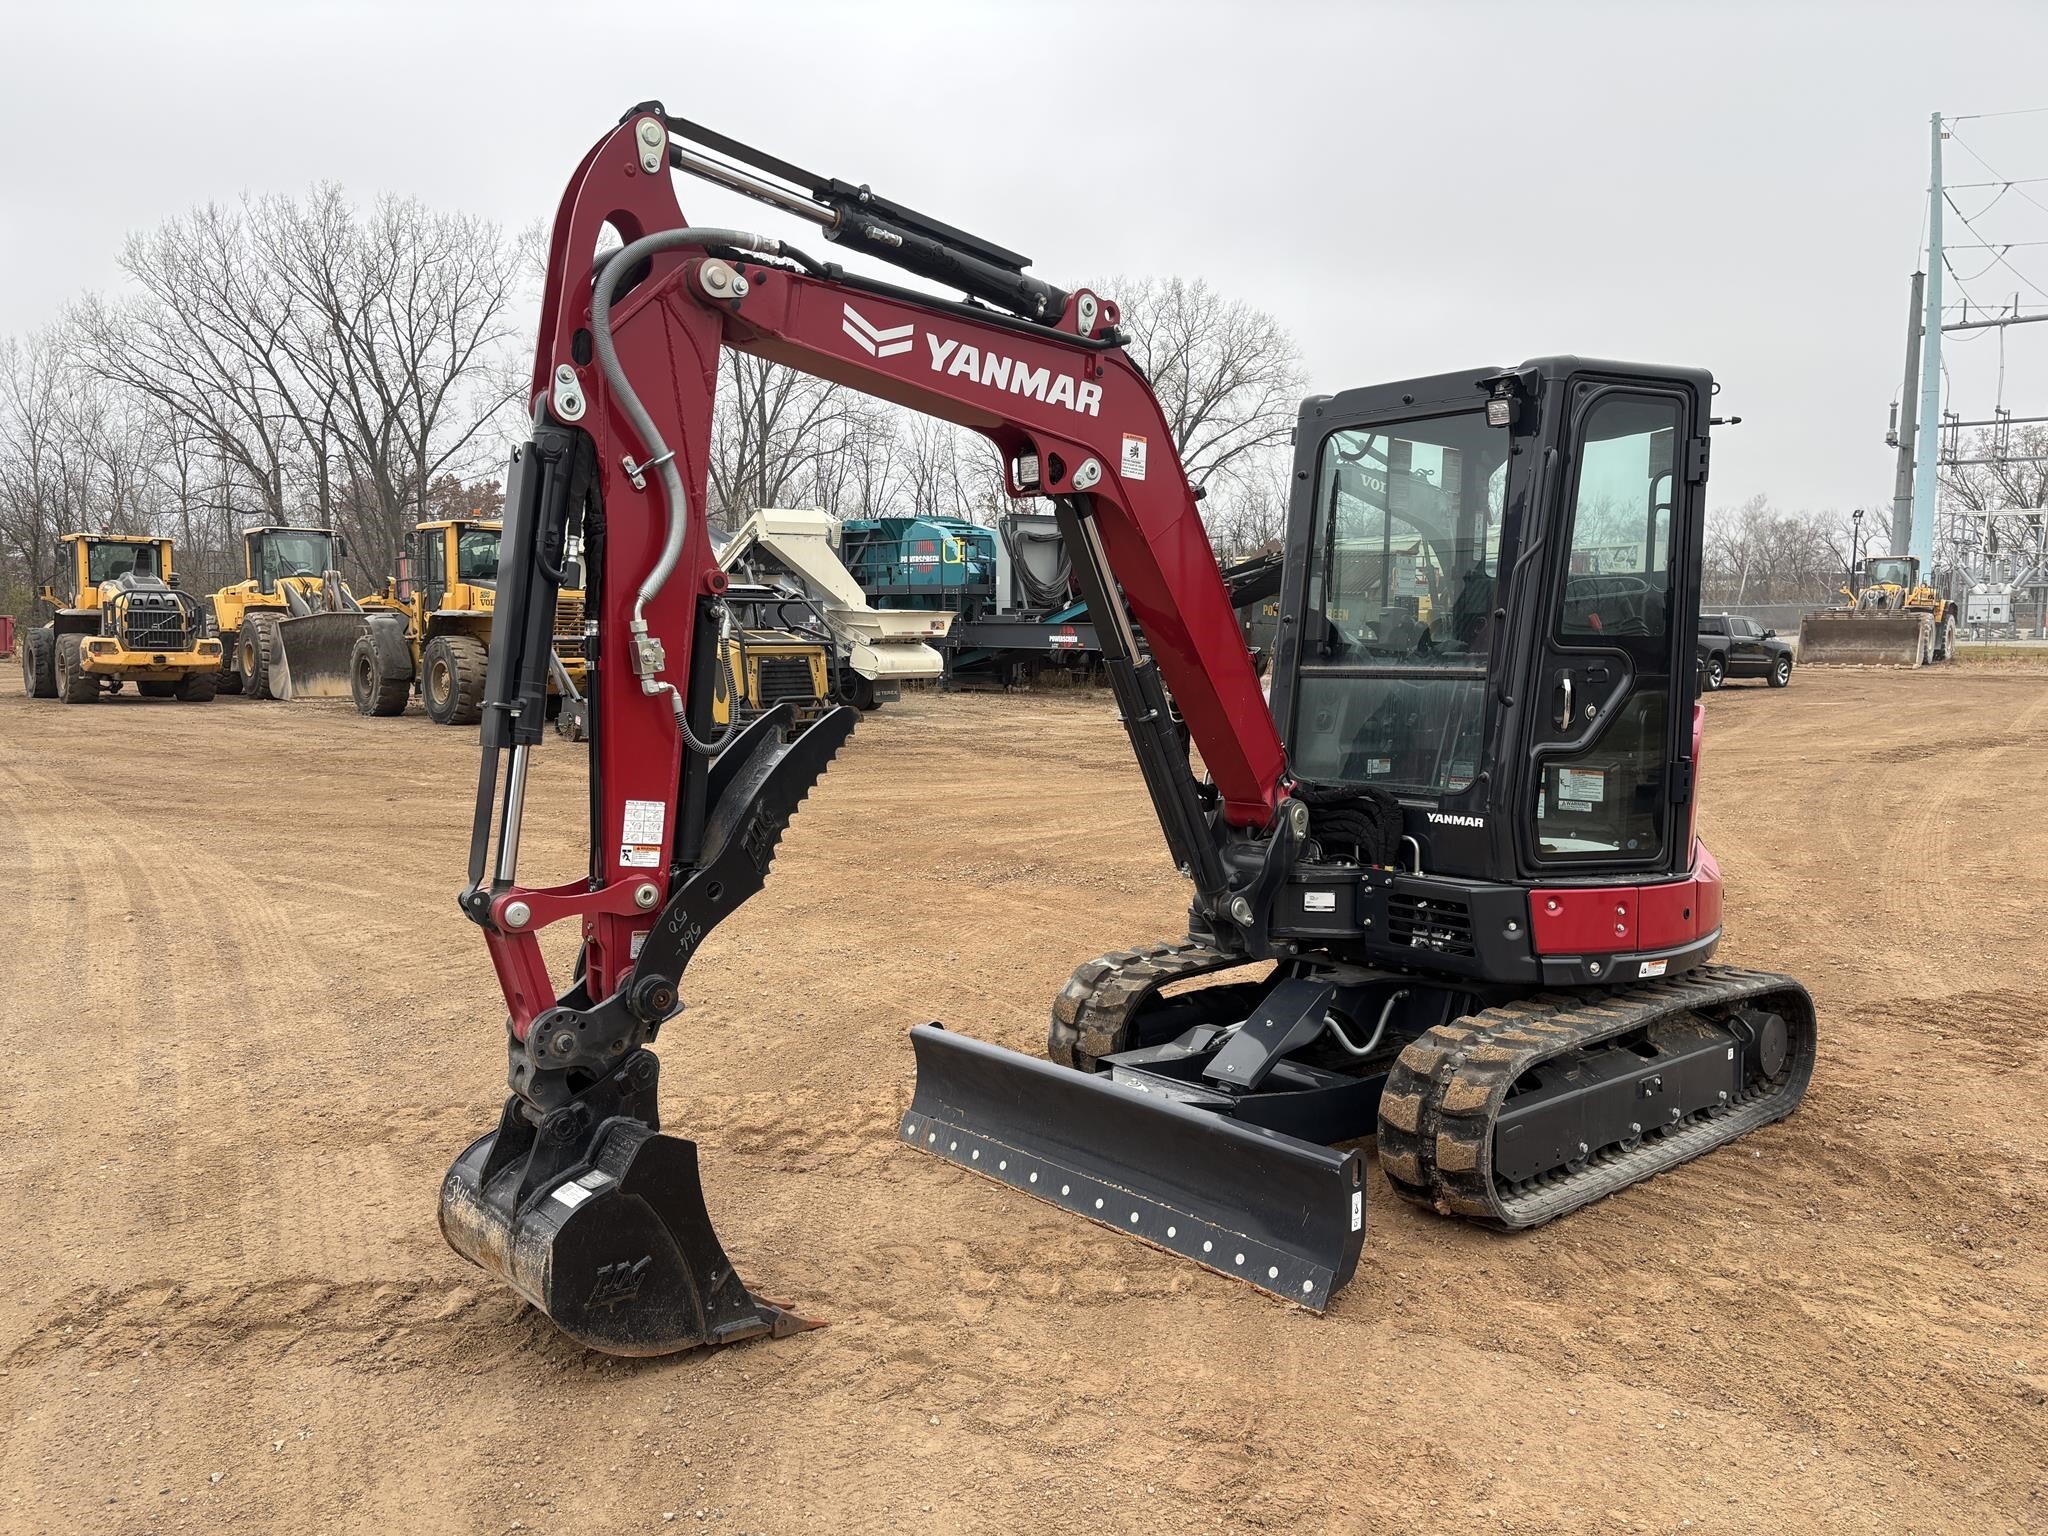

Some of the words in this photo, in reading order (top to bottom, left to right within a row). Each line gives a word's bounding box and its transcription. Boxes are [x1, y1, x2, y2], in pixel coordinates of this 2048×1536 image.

[926, 332, 1103, 417] YANMAR
[1360, 473, 1387, 494] VOL
[480, 599, 496, 607] VOL
[1426, 812, 1484, 828] YANMAR
